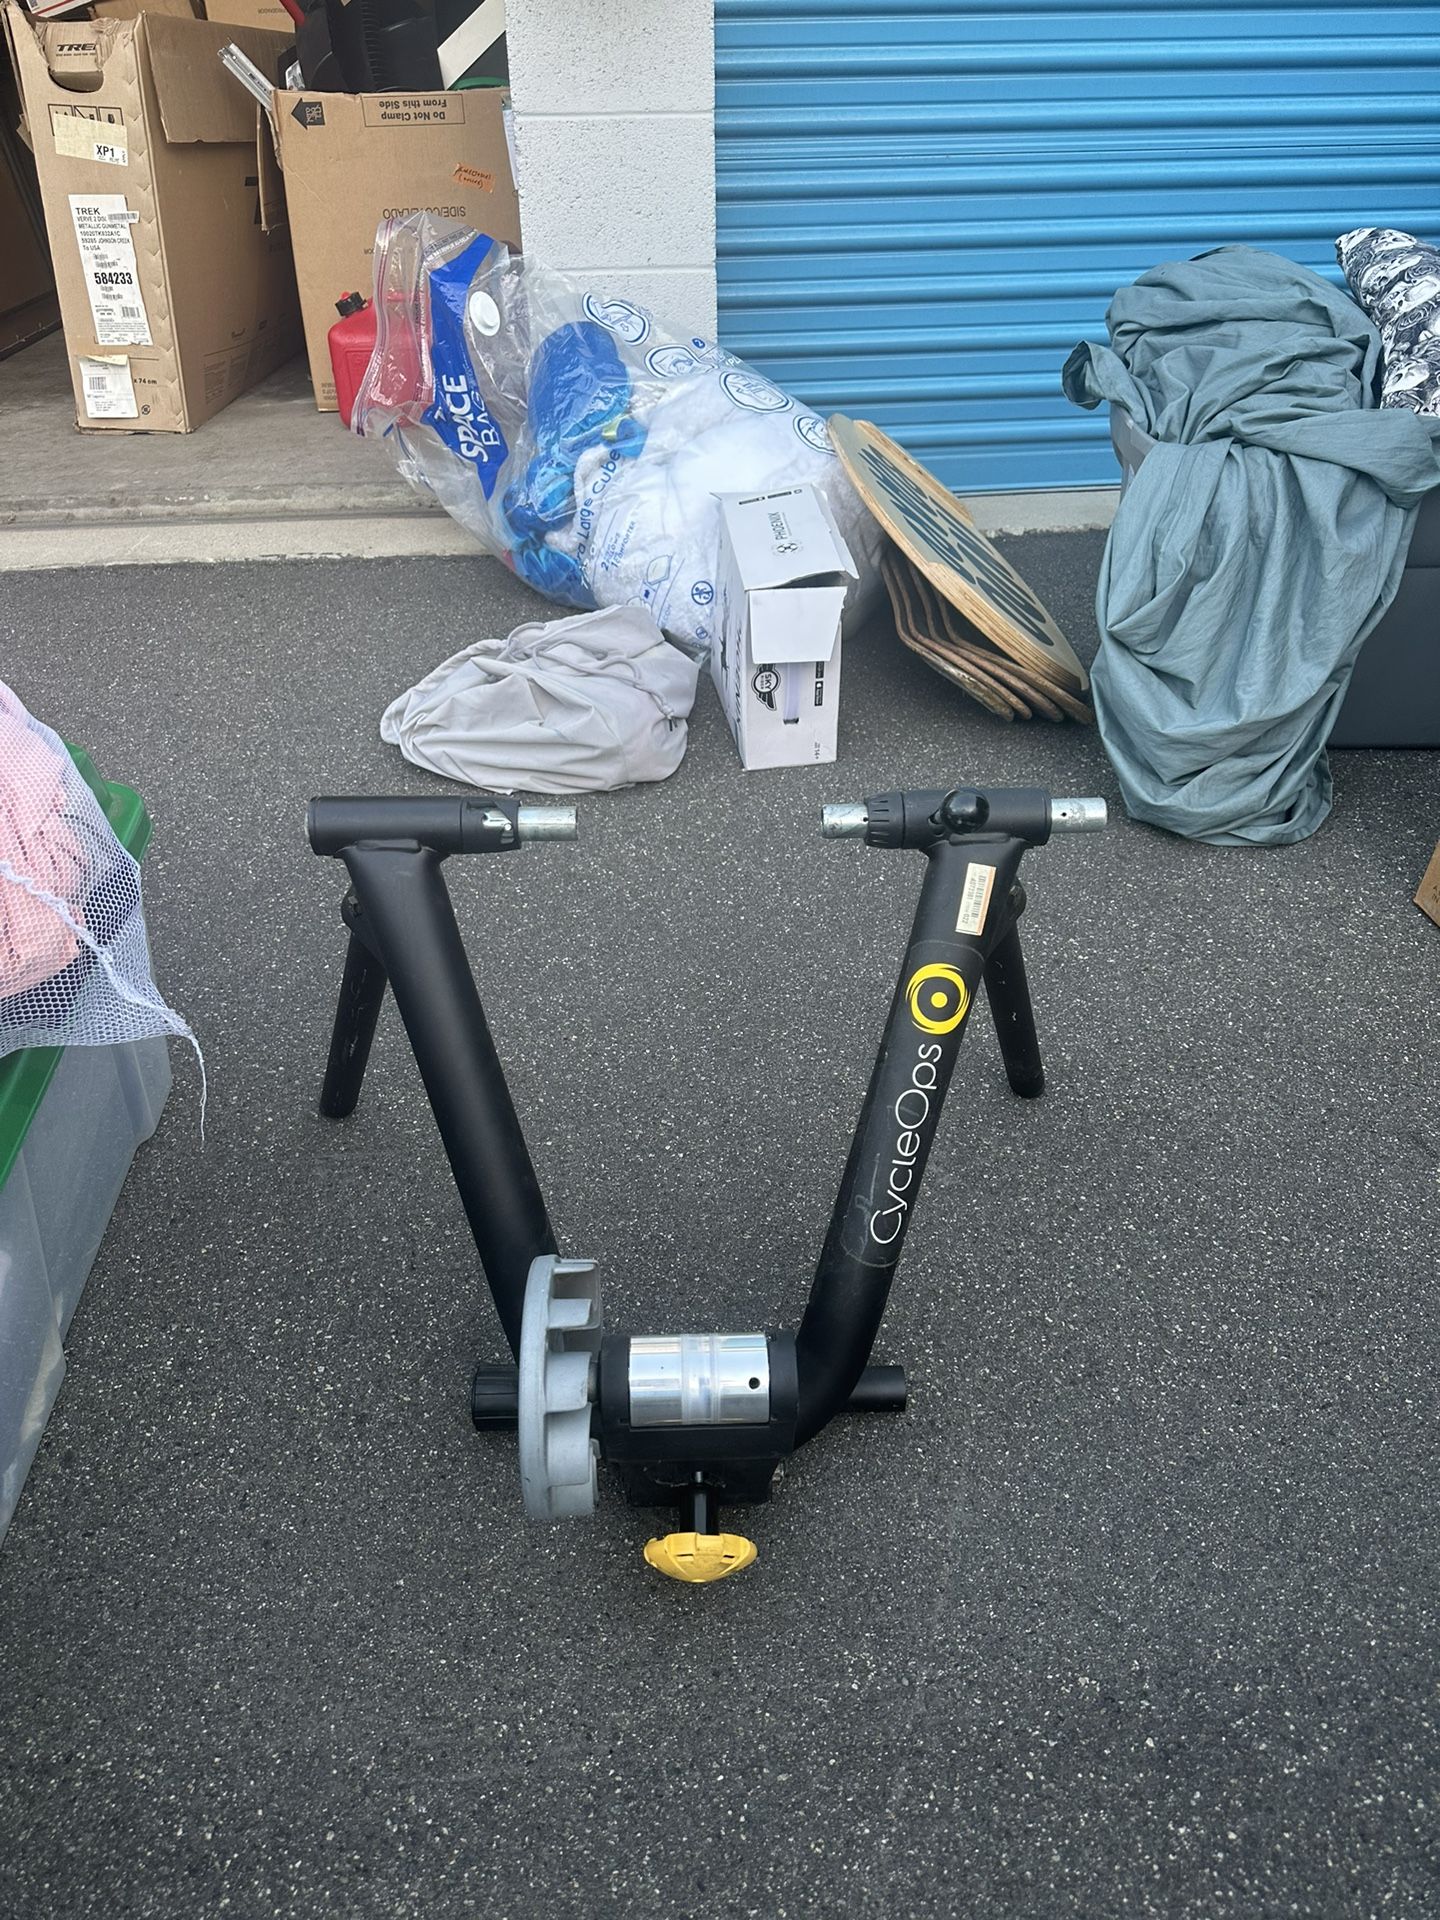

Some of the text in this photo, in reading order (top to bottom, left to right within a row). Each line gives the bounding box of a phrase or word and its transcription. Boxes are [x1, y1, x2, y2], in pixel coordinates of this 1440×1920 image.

[379, 98, 448, 109] From this Side
[381, 111, 445, 121] Do Not Clamp
[95, 144, 115, 157] XP1
[75, 207, 101, 216] TREK
[94, 272, 133, 285] 584233
[441, 374, 488, 463] SPACE
[473, 392, 500, 446] BAG
[577, 498, 595, 541] Large
[592, 448, 620, 495] Cube
[767, 511, 788, 541] PHOENIX
[764, 673, 772, 690] SKY
[870, 1043, 943, 1246] CycleOps
